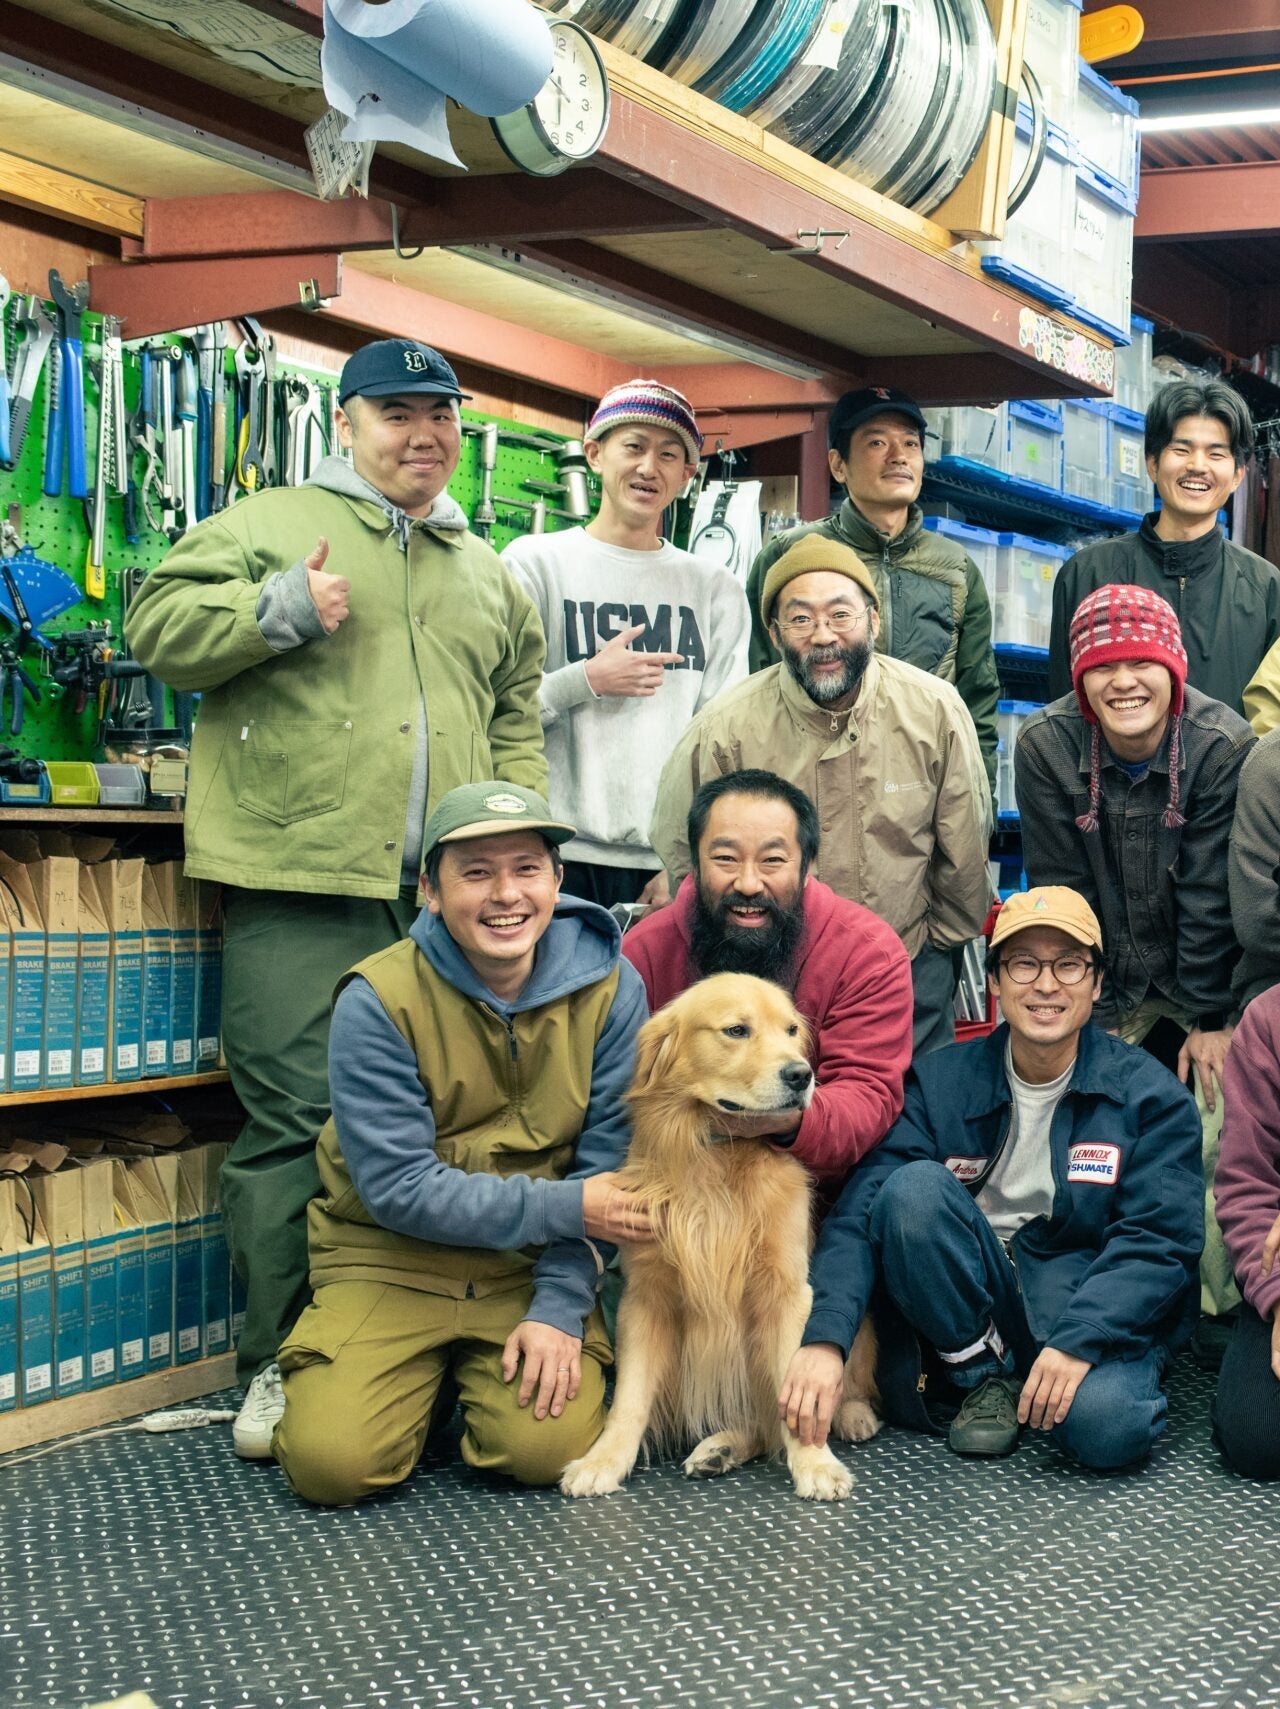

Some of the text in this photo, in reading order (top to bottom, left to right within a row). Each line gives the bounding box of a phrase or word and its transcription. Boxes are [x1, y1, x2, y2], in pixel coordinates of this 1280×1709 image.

[579, 73, 588, 88] 2
[581, 98, 590, 112] 3
[576, 120, 584, 132] 4
[565, 131, 574, 145] 5
[16, 960, 44, 969] BRAKE
[50, 961, 76, 970] BRAKE
[117, 958, 141, 967] BRAKE
[1073, 1149, 1113, 1160] LENNOX
[119, 1254, 143, 1268] SHIFT
[149, 1248, 171, 1262] SHIFT
[90, 1262, 114, 1276] SHIFT
[23, 1274, 49, 1290] SHIFT
[58, 1269, 83, 1286] SHIFT
[0, 1283, 18, 1296] HIFT
